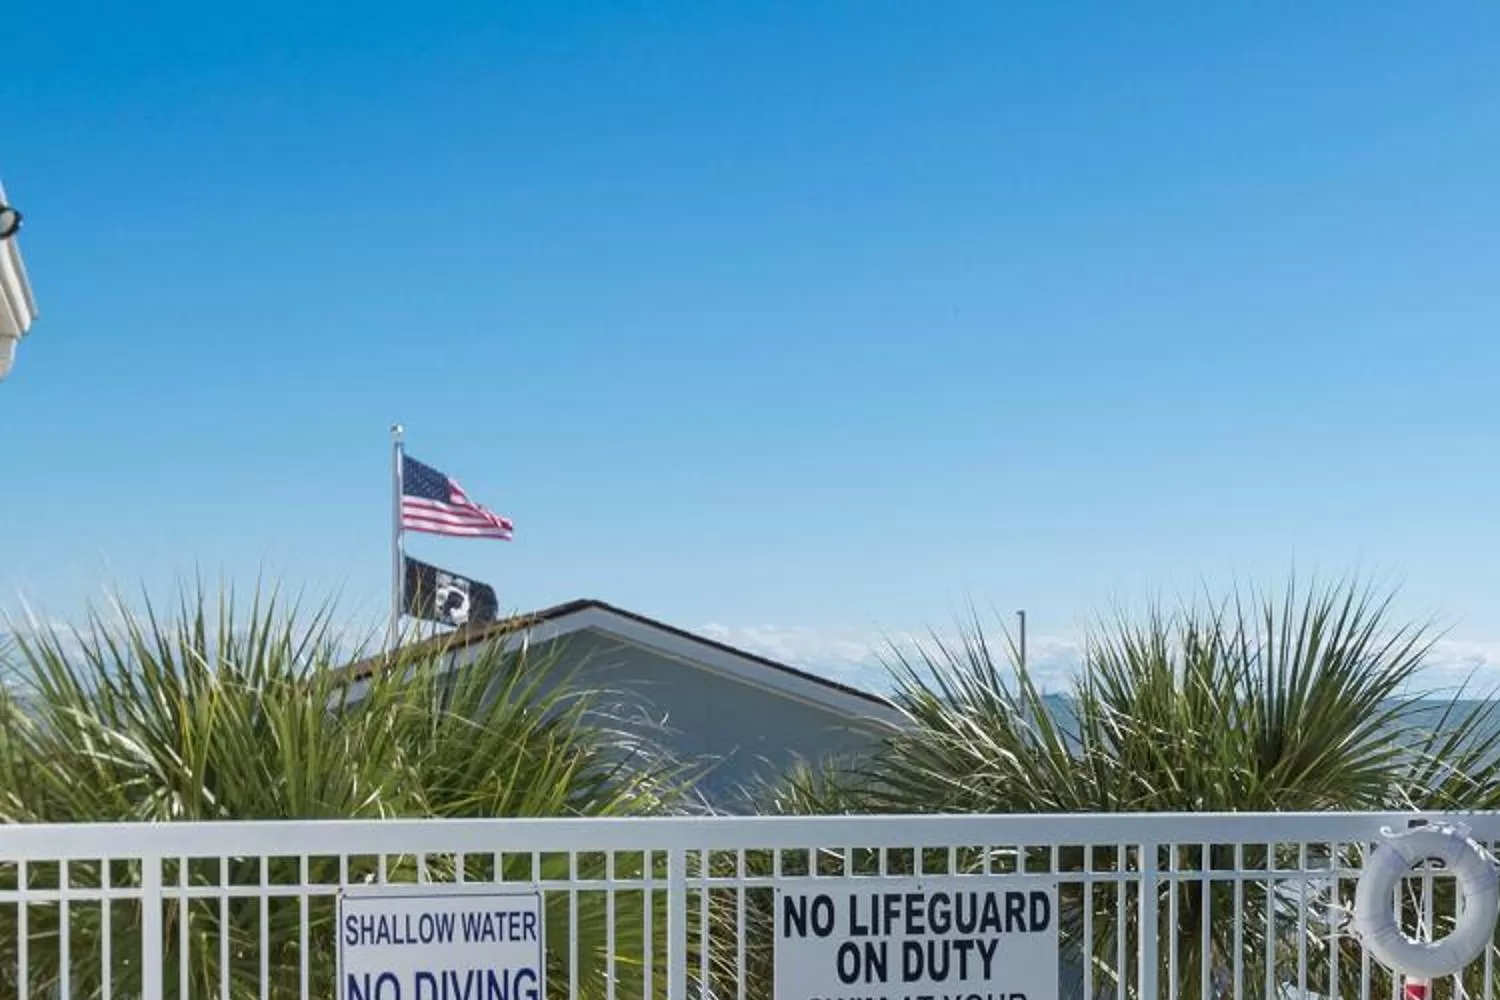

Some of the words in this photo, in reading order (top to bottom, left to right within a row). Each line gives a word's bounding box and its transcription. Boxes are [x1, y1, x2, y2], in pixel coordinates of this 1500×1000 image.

[345, 913, 455, 946] SHALLOW
[462, 911, 538, 943] WATER
[783, 893, 835, 938] NO
[849, 890, 1051, 936] LIFEGUARD
[837, 940, 888, 984] ON
[902, 938, 999, 983] DUTY
